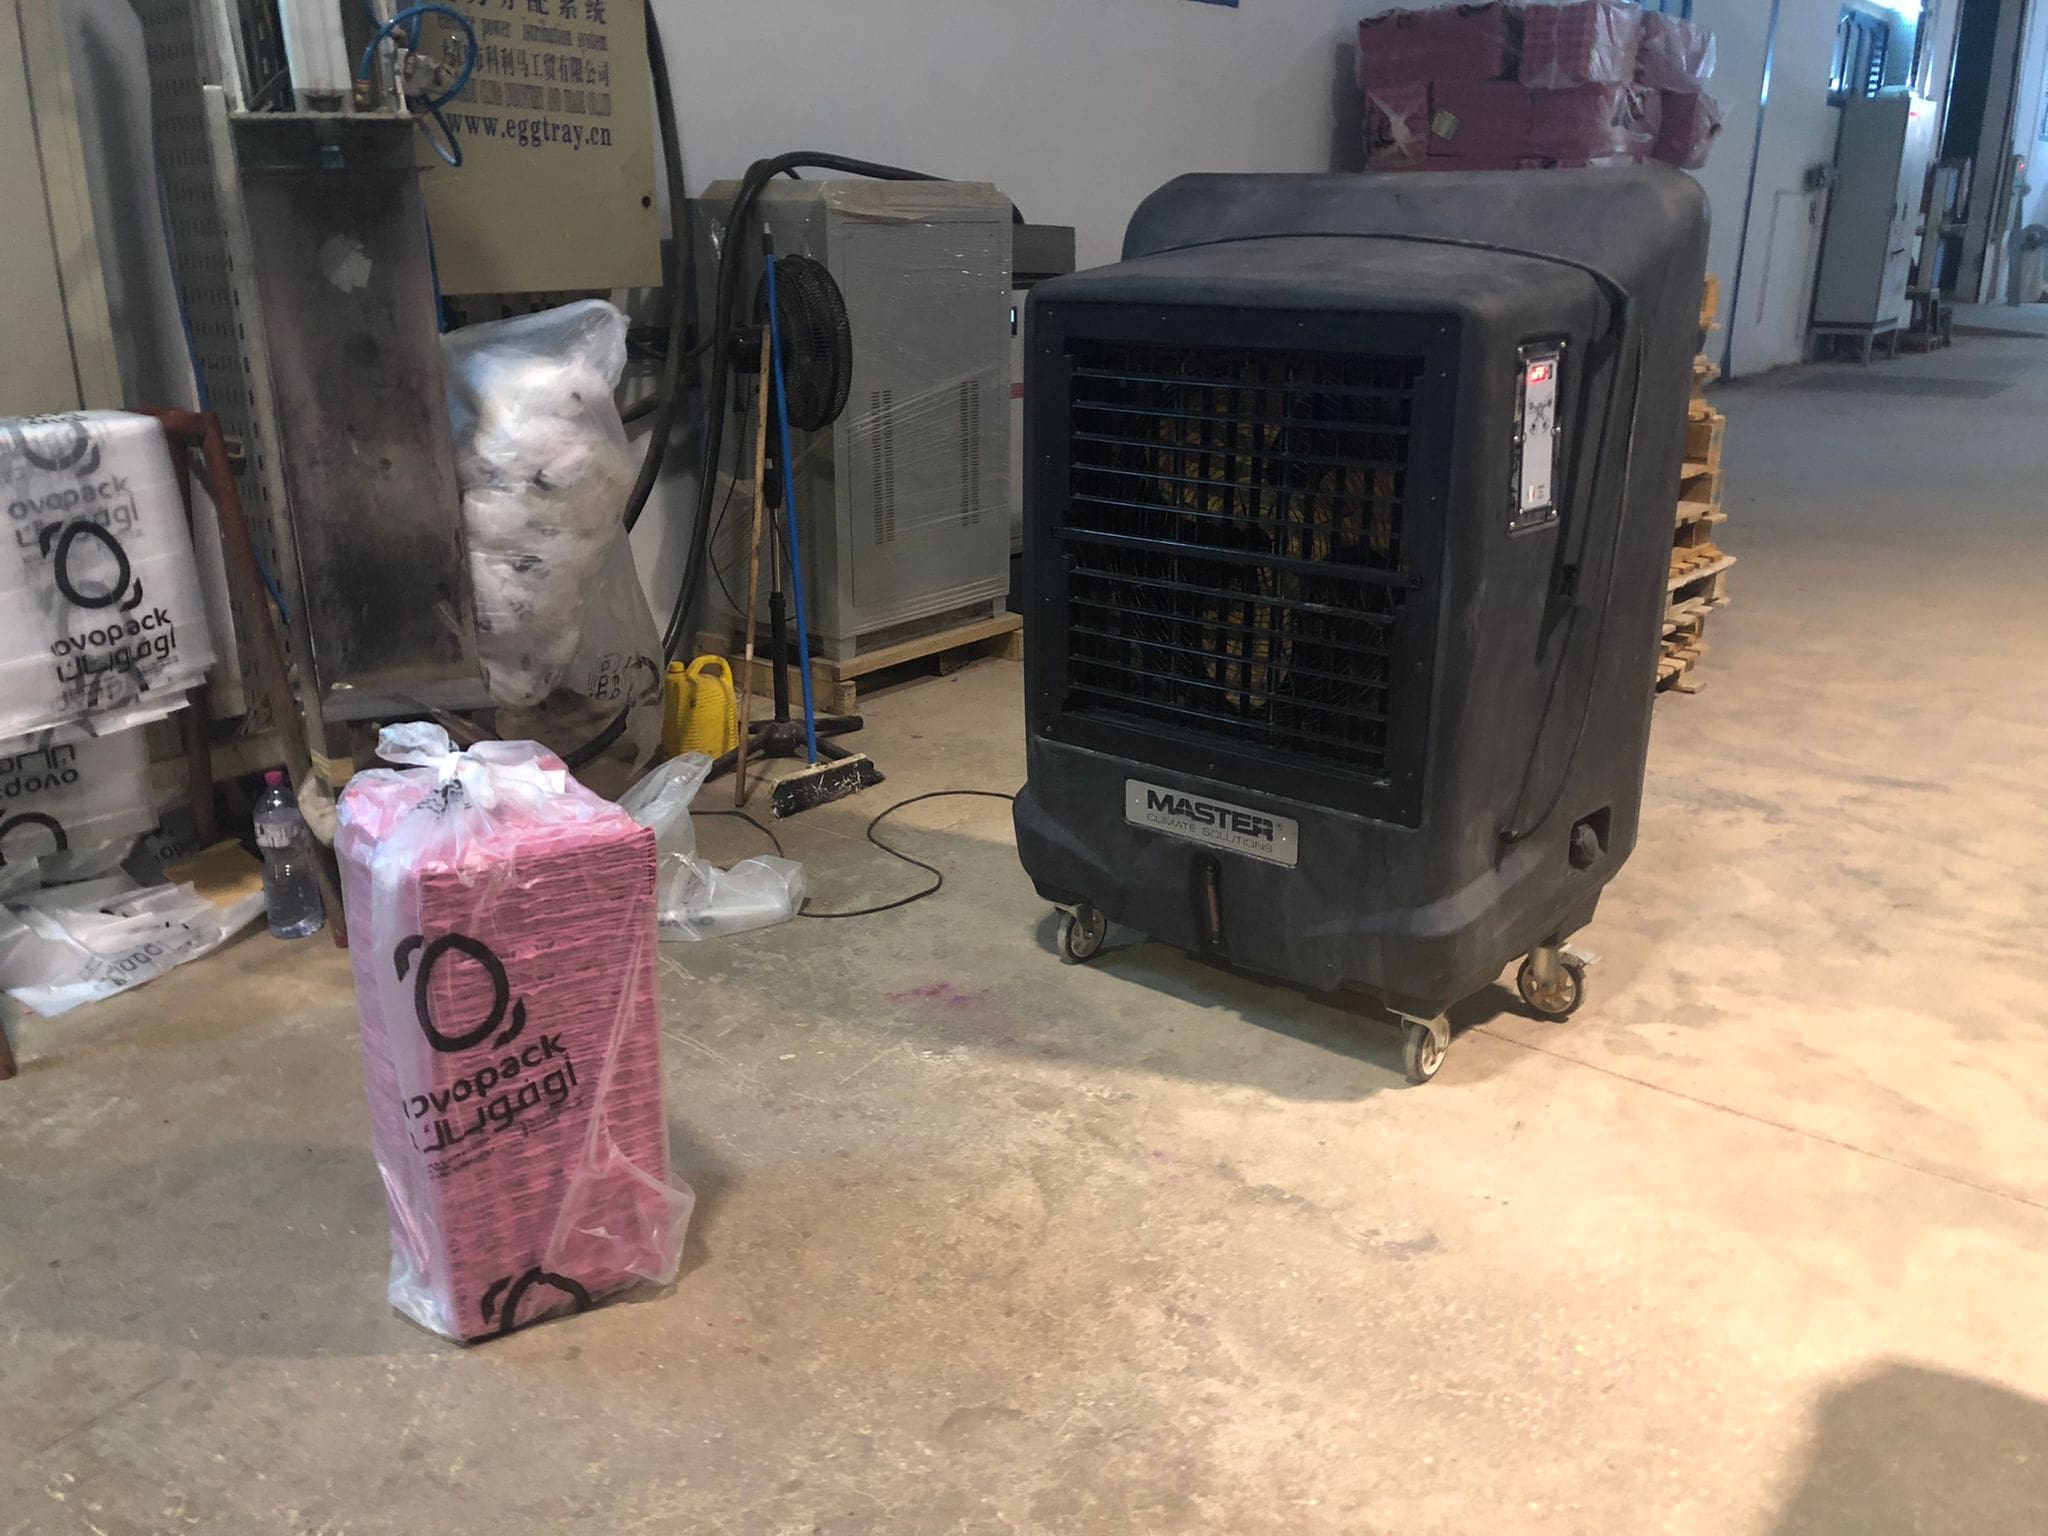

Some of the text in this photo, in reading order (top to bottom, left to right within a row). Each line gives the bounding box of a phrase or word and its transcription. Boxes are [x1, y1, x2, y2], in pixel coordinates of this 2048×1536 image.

[446, 113, 612, 150] www.eggtray.cn
[51, 608, 171, 656] ovopack
[1147, 789, 1273, 842] MASTER
[1147, 812, 1273, 853] CLIMATE SOLUTIONS
[403, 1032, 567, 1120] ovopack
